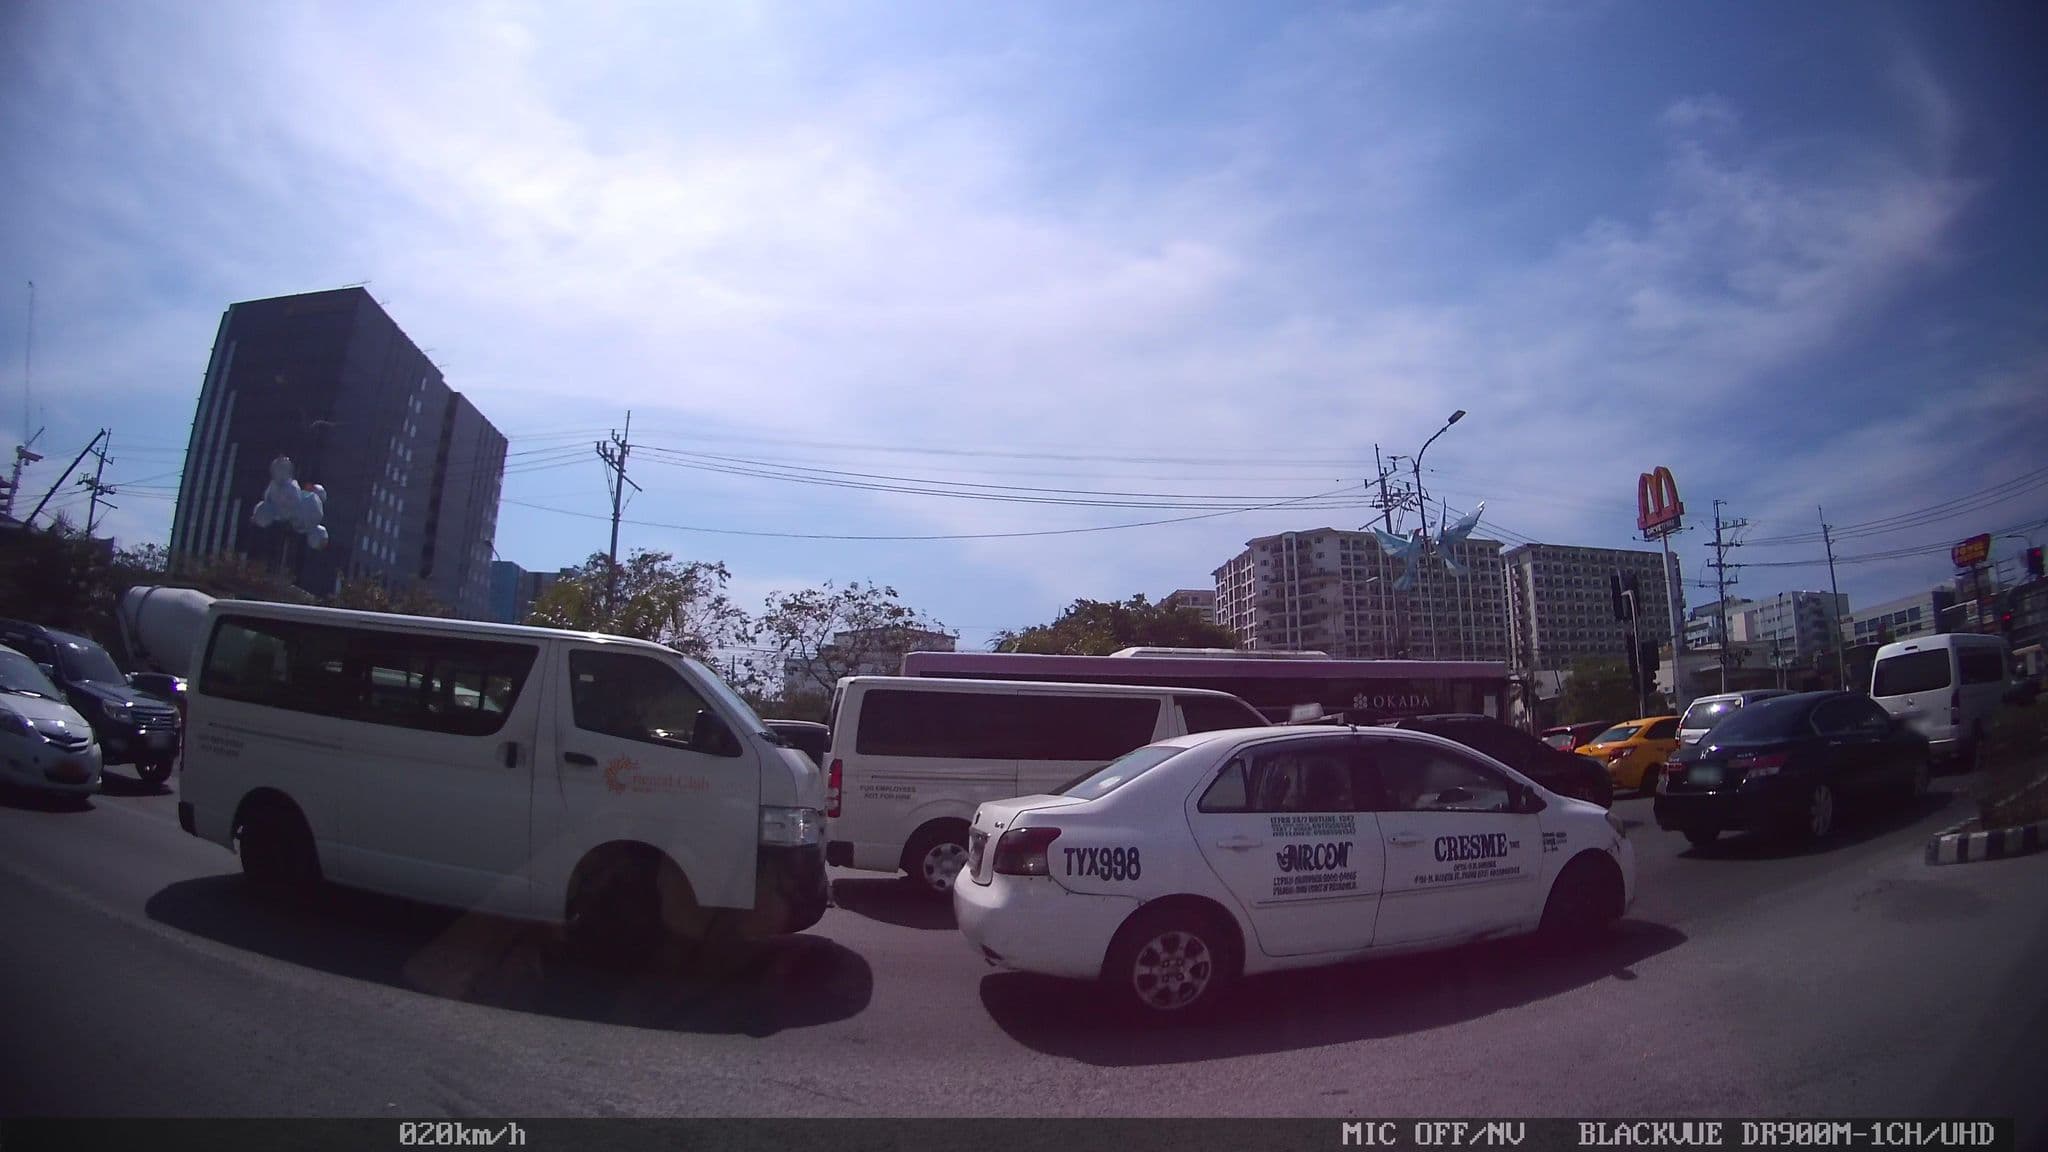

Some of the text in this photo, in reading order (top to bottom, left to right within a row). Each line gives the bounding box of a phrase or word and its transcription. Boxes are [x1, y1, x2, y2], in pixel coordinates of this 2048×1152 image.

[1373, 695, 1430, 708] OKADA
[1276, 842, 1353, 872] AIRCON
[1434, 833, 1508, 862] CRESME
[1064, 847, 1141, 881] TYX998
